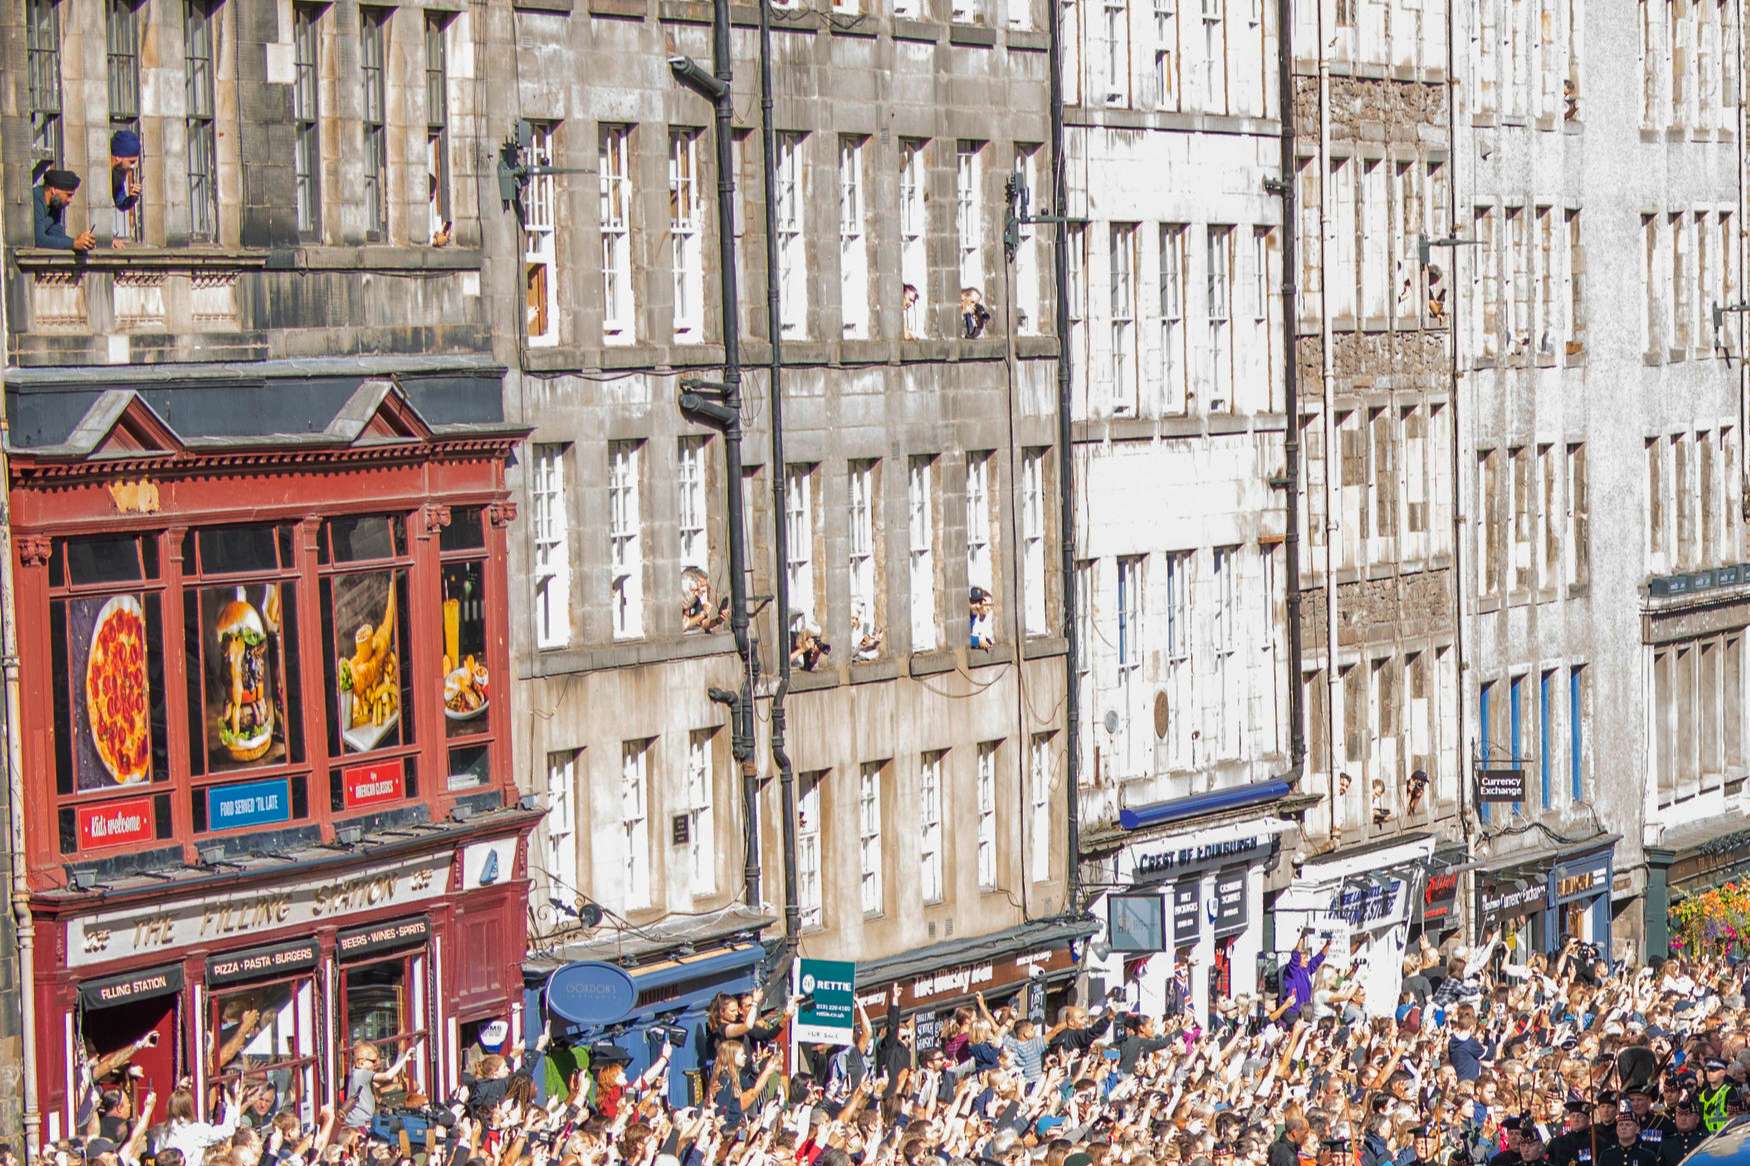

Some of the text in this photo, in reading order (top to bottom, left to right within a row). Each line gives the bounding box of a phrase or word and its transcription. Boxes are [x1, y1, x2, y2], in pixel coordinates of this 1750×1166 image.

[1480, 786, 1522, 797] Exchange
[1481, 776, 1522, 787] Currency
[219, 802, 234, 817] FOOD
[234, 799, 255, 816] SERVED
[264, 795, 279, 811] LATE
[90, 811, 141, 838] Kids welcome
[1139, 836, 1258, 875] CREST OF EDINBURGH
[133, 916, 174, 950] THE
[200, 895, 291, 937] FILLING
[341, 922, 426, 950] BEERS WINES SPIRITS
[214, 948, 313, 976] PIZZA PASTA BURGERS
[101, 976, 167, 1001] FILLING STATION
[816, 980, 852, 992] RETTIE
